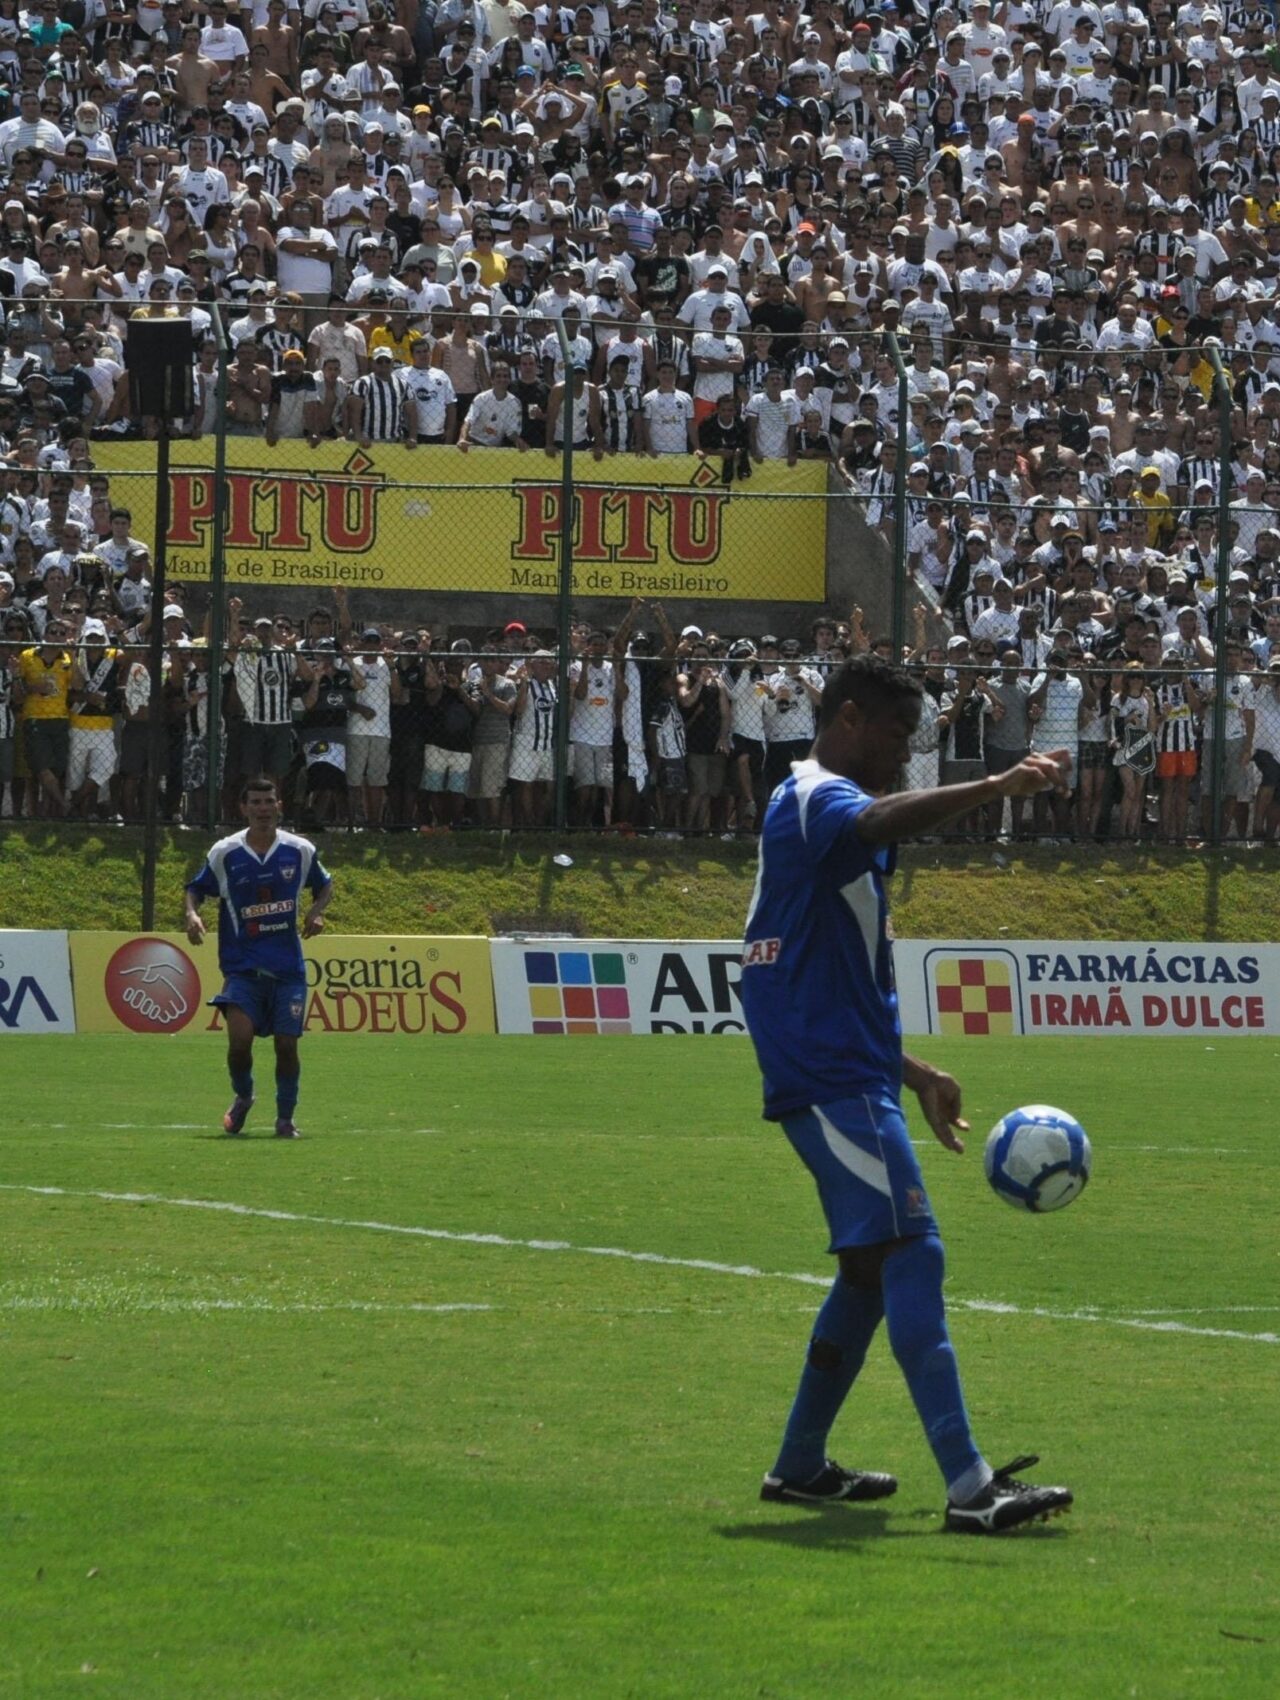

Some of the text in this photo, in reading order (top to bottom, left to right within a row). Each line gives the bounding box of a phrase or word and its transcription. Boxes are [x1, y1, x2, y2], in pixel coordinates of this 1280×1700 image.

[165, 449, 386, 554] PITÚ
[511, 461, 730, 565] PITÚ
[237, 556, 263, 577] de
[271, 560, 384, 581] Brasileiro
[587, 570, 612, 589] de
[620, 572, 729, 592] Brasileiro
[1026, 947, 1260, 984] FARMÁCIAS
[1030, 986, 1265, 1028] IRMÃ DULCE
